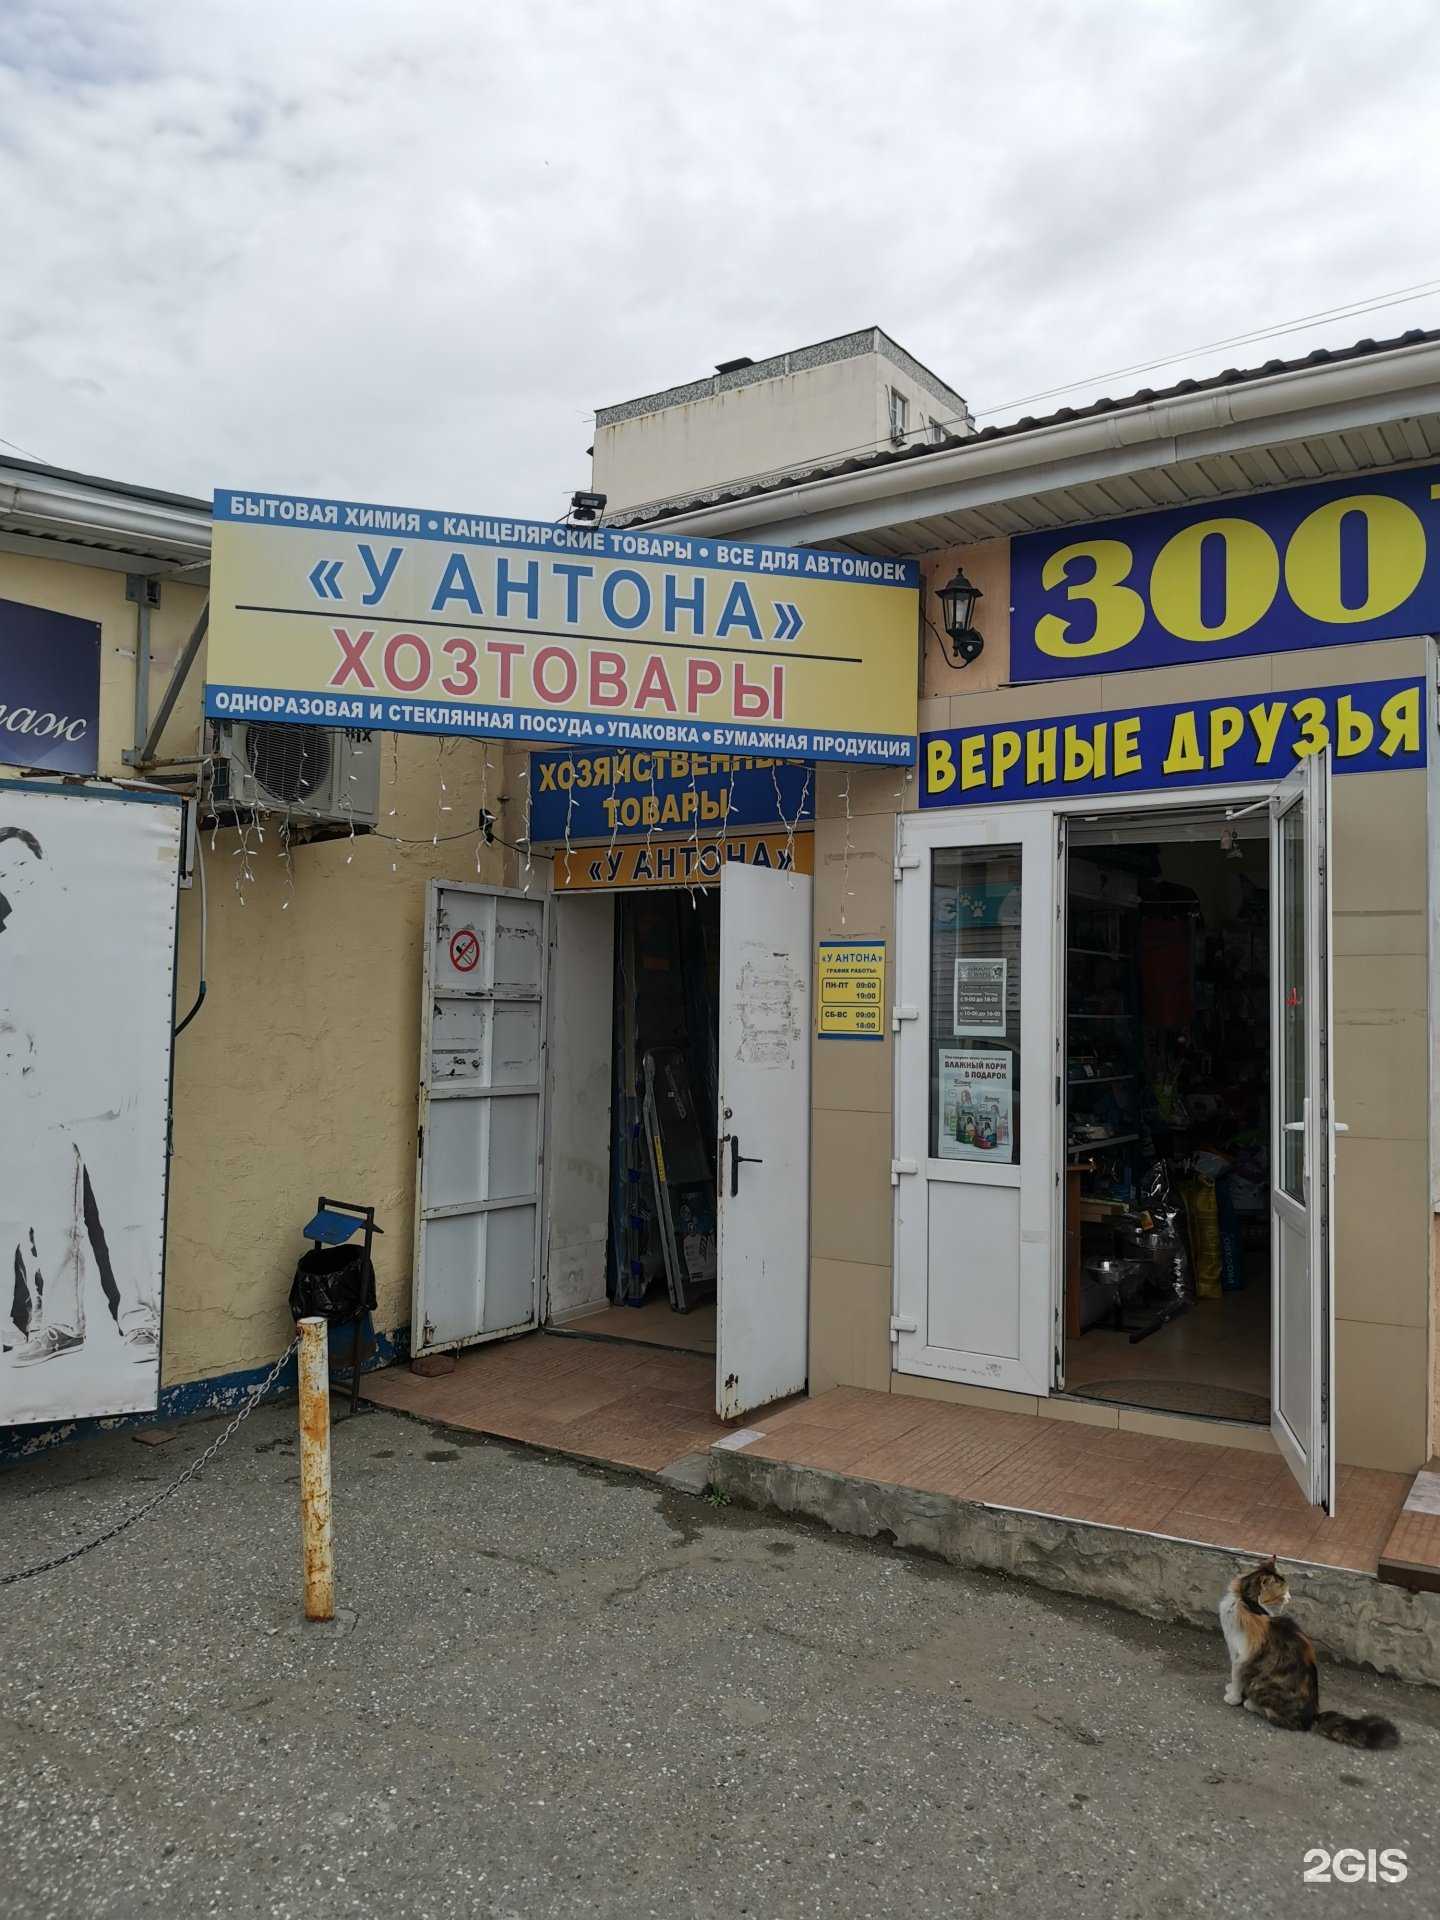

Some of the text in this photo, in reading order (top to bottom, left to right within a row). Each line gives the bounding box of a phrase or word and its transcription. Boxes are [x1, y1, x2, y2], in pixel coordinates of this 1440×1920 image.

[230, 496, 906, 581] БЫТОВАЯ ХИМИЯ КАНЦЕЛЯРСКИЕ ТОВАРЫ ВСЕ ДЛЯ АВТОМОЕК
[1034, 484, 1440, 658] ЗОО
[307, 543, 805, 641] «У АНТОНА»
[329, 628, 784, 720] ХОЗТОВАРЫ
[215, 692, 911, 757] ОДНОРАЗОВАЯ И СТЕКЛЯННАЯ ПОСУДА УПАКОВКА БУМАЖНАЯ ПРОДУКЦИЯ
[926, 687, 1421, 796] ВЕРНЫЕ ДРУЗЬЯ
[603, 789, 727, 828] ТОВАРЫ
[588, 850, 624, 882] «У
[945, 1061, 984, 1070] ВЛАЖНЫЙ
[971, 1071, 1007, 1080] ПОДАРОК
